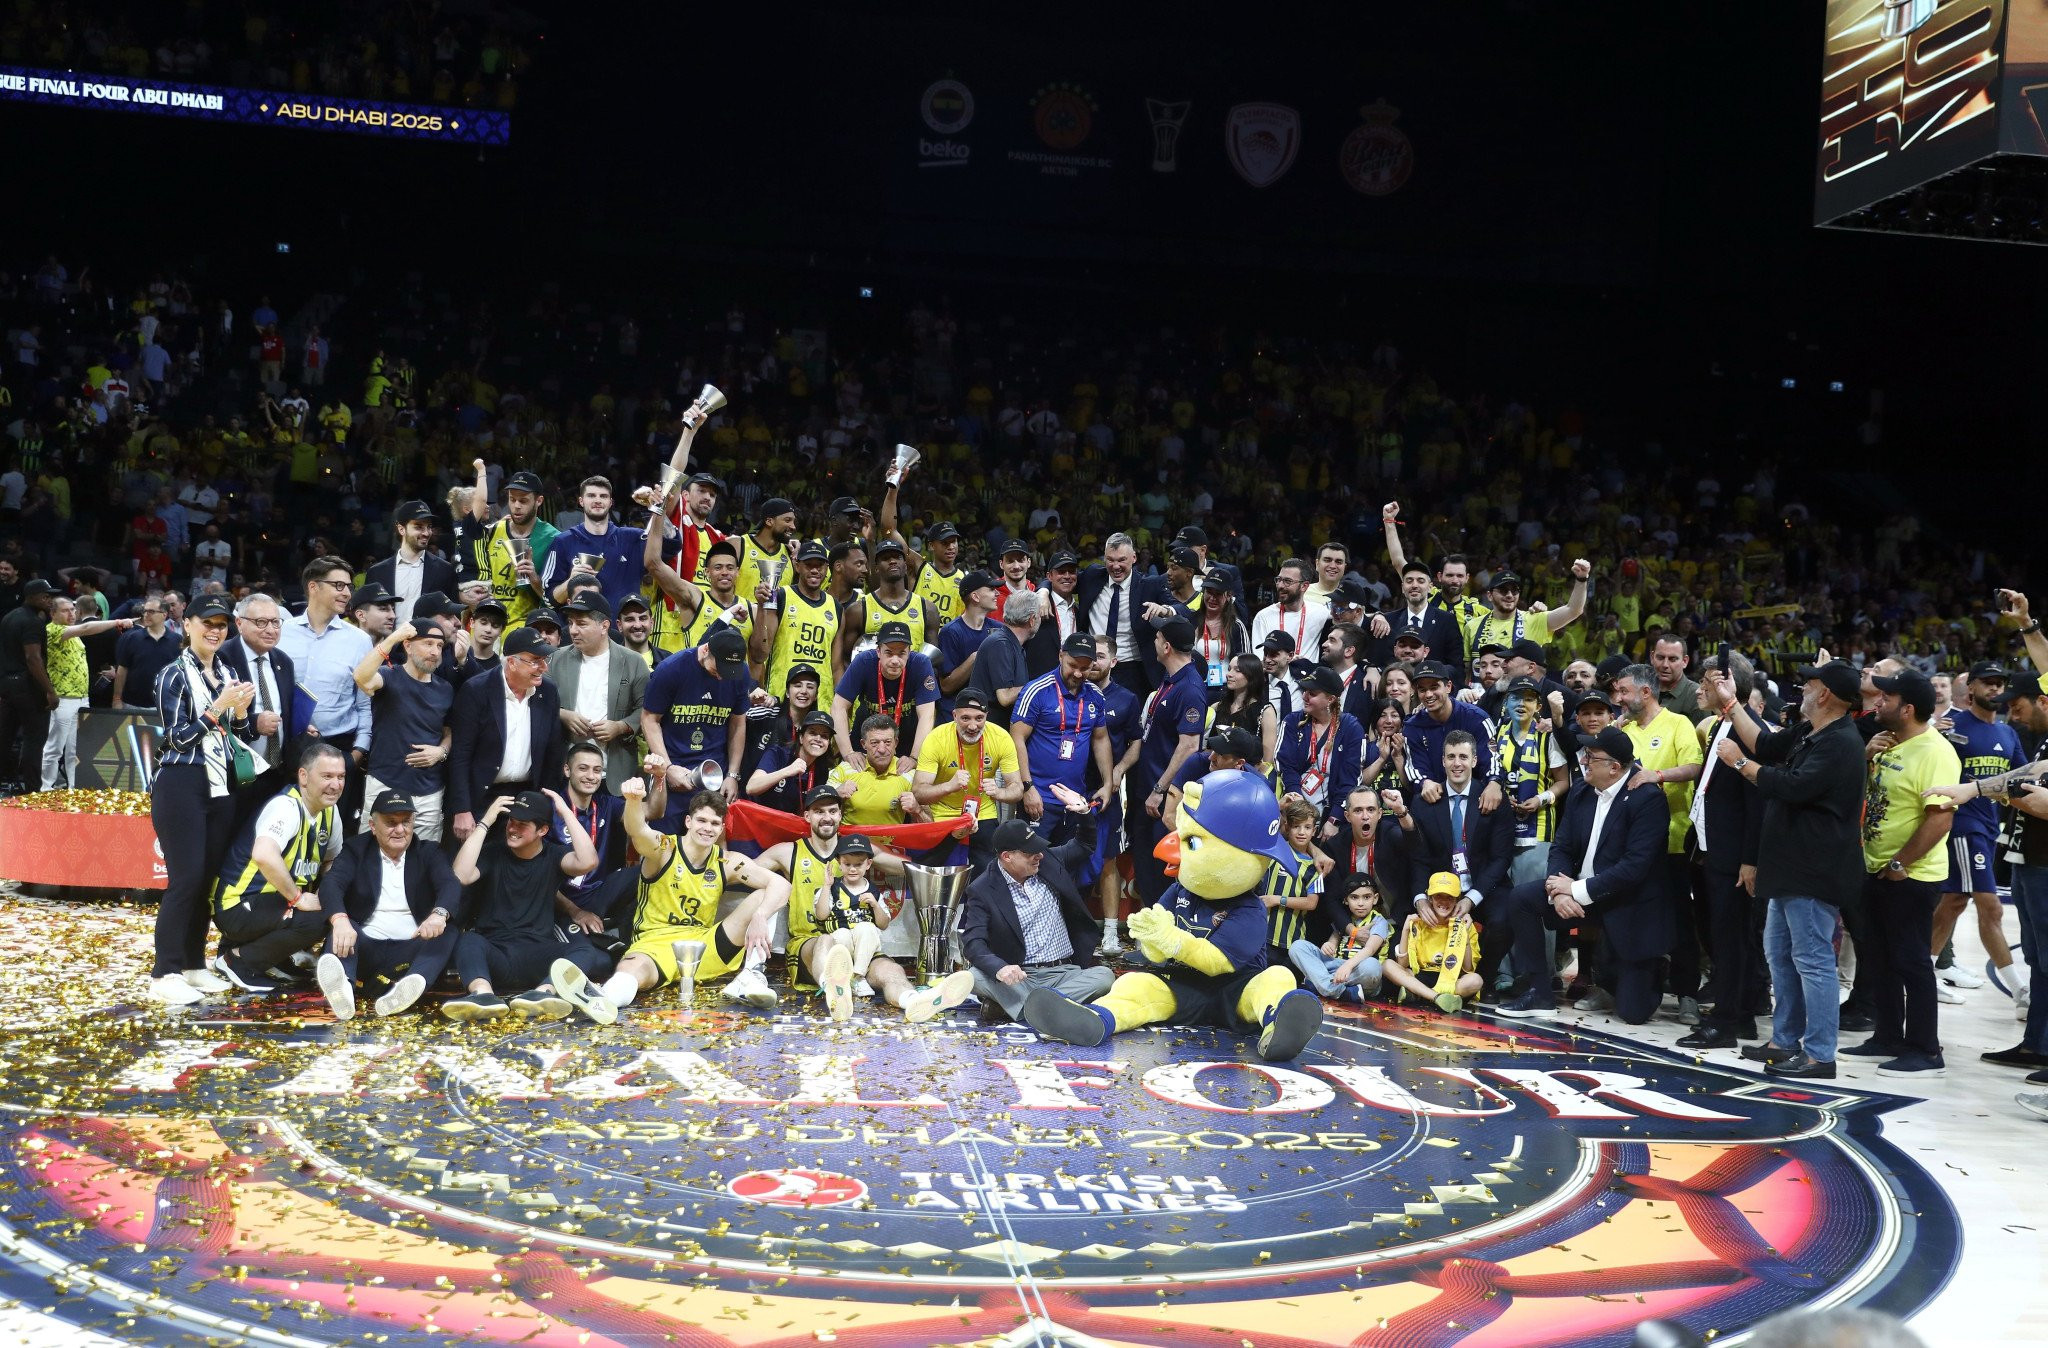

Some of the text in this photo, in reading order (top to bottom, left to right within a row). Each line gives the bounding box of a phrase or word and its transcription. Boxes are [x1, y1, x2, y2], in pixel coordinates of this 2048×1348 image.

[29, 77, 79, 97] FINAL
[83, 82, 129, 102] FOUR
[132, 87, 168, 105] ABU
[171, 92, 223, 110] DHABI
[277, 103, 443, 131] ABU DHABI 2025
[919, 137, 970, 158] beko
[499, 562, 511, 581] 4
[801, 622, 826, 645] 50
[793, 641, 827, 661] beko
[153, 863, 168, 873] be
[679, 895, 701, 917] 13
[985, 1058, 1752, 1122] FOUR
[1130, 1129, 1383, 1151] 2025
[899, 1169, 1228, 1194] TURKISH
[901, 1189, 1249, 1214] AIRLINES
